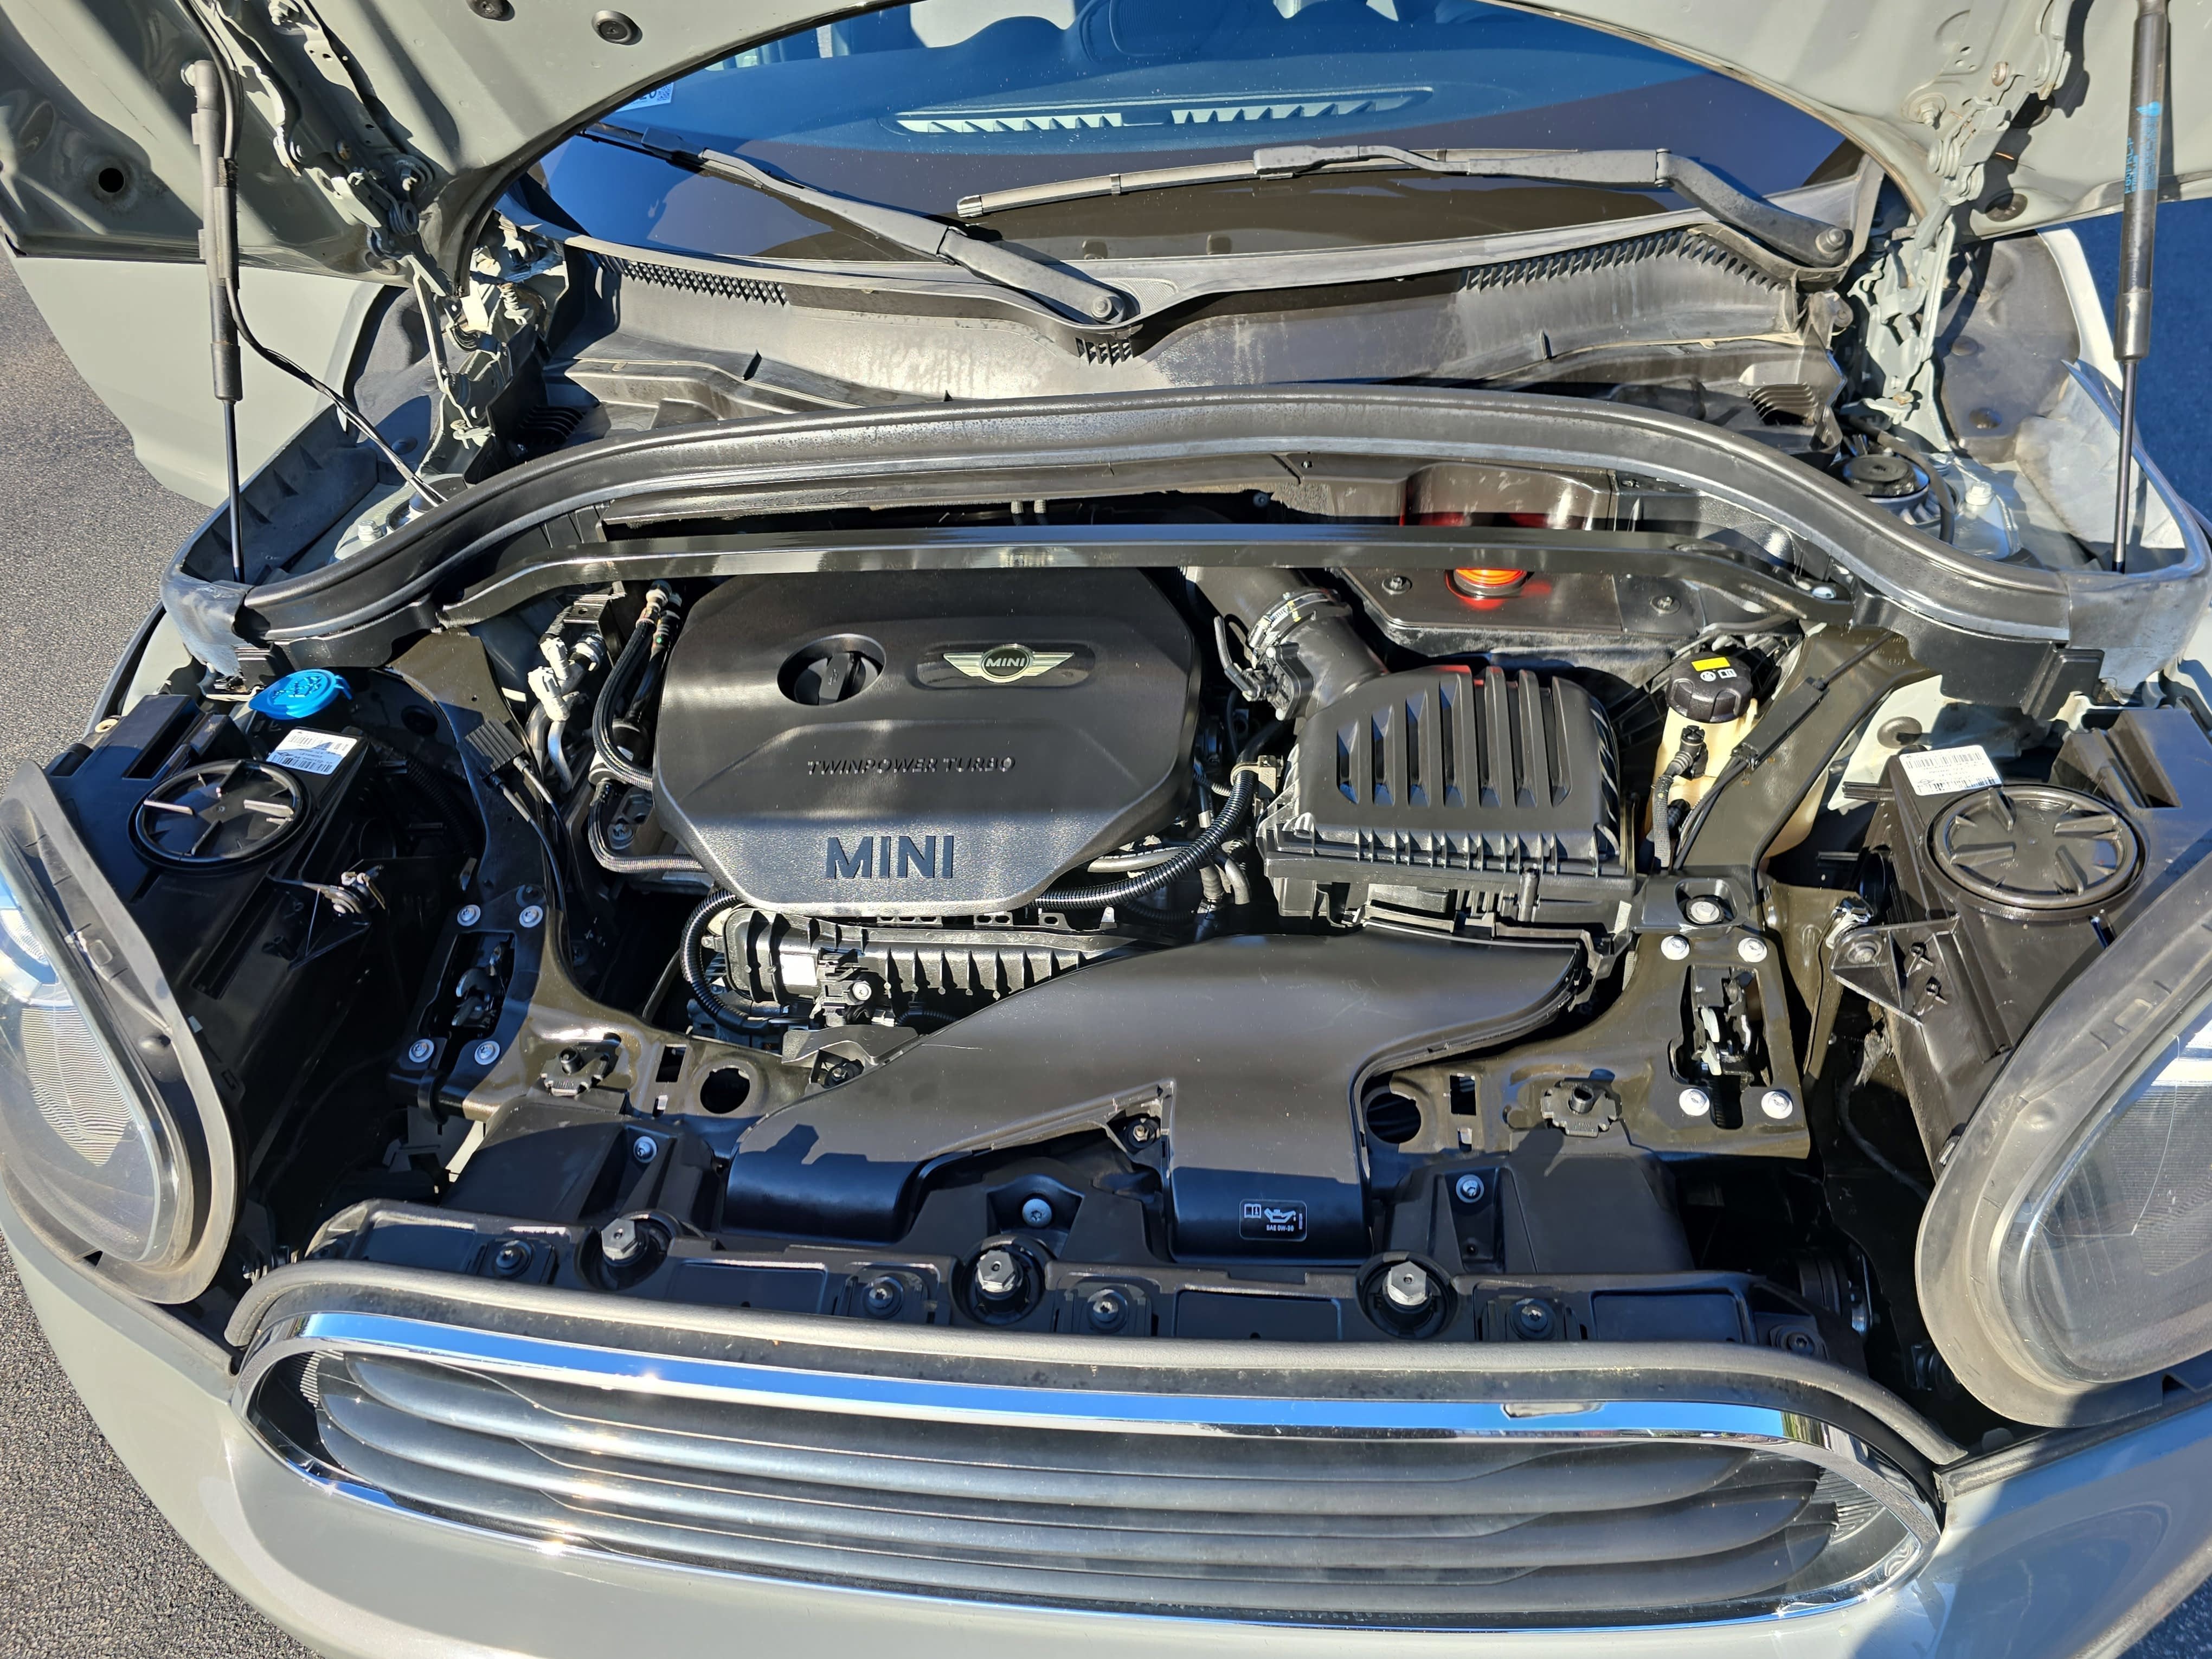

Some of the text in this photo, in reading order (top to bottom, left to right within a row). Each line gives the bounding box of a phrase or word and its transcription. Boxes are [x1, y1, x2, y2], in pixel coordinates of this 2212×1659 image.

[986, 657, 1025, 667] MINI
[807, 756, 1015, 775] TWINPOWER TURBO
[825, 835, 954, 880] MINI
